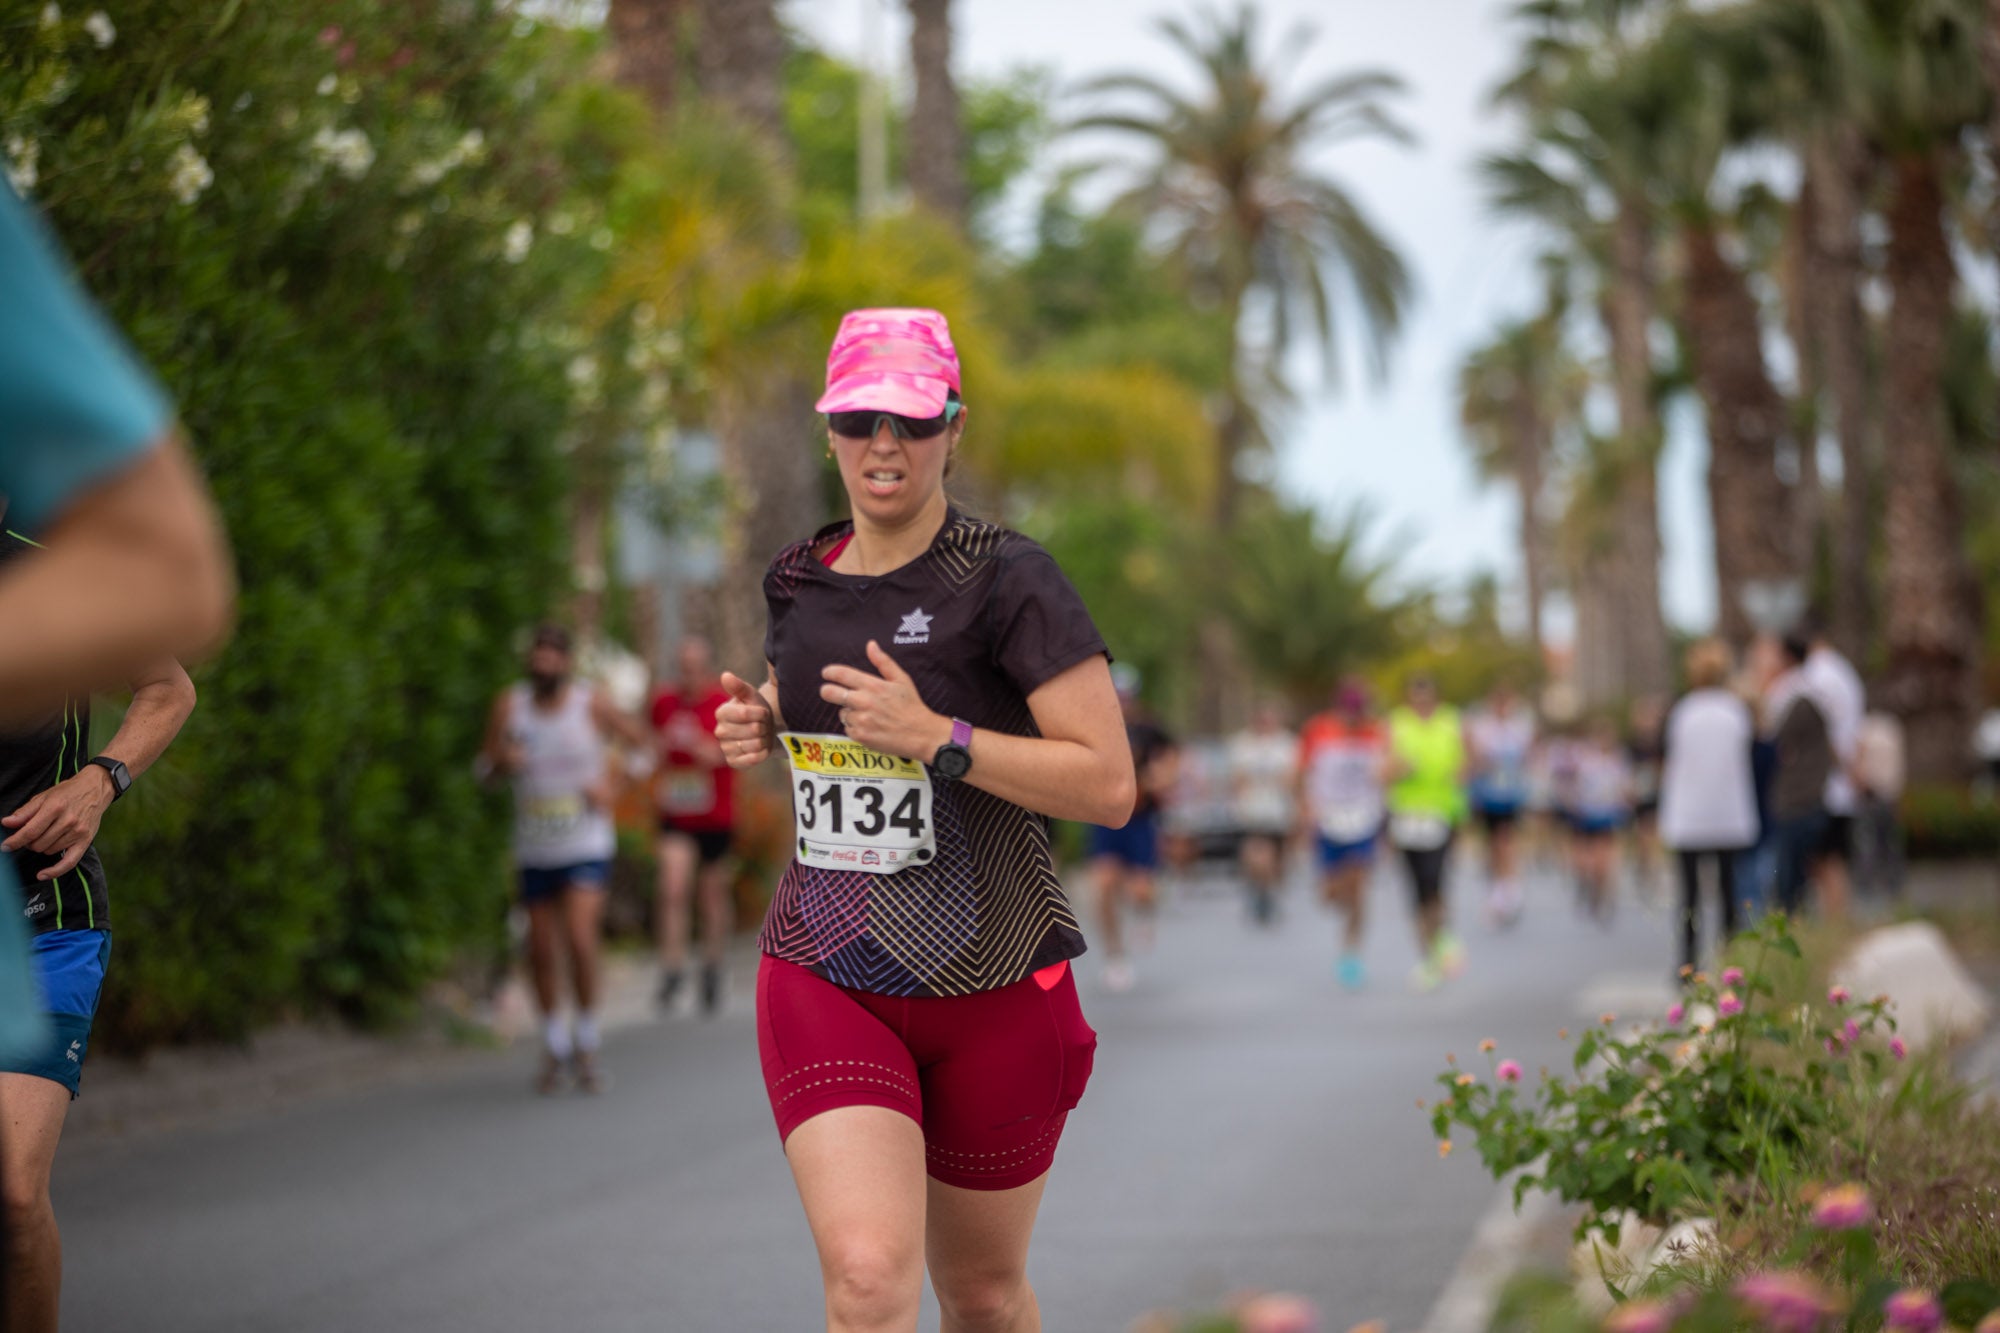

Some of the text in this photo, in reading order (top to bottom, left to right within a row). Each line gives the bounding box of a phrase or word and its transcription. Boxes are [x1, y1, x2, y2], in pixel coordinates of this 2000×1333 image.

[803, 742, 822, 764] 38
[821, 751, 895, 771] FONDO
[798, 779, 926, 839] 3134
